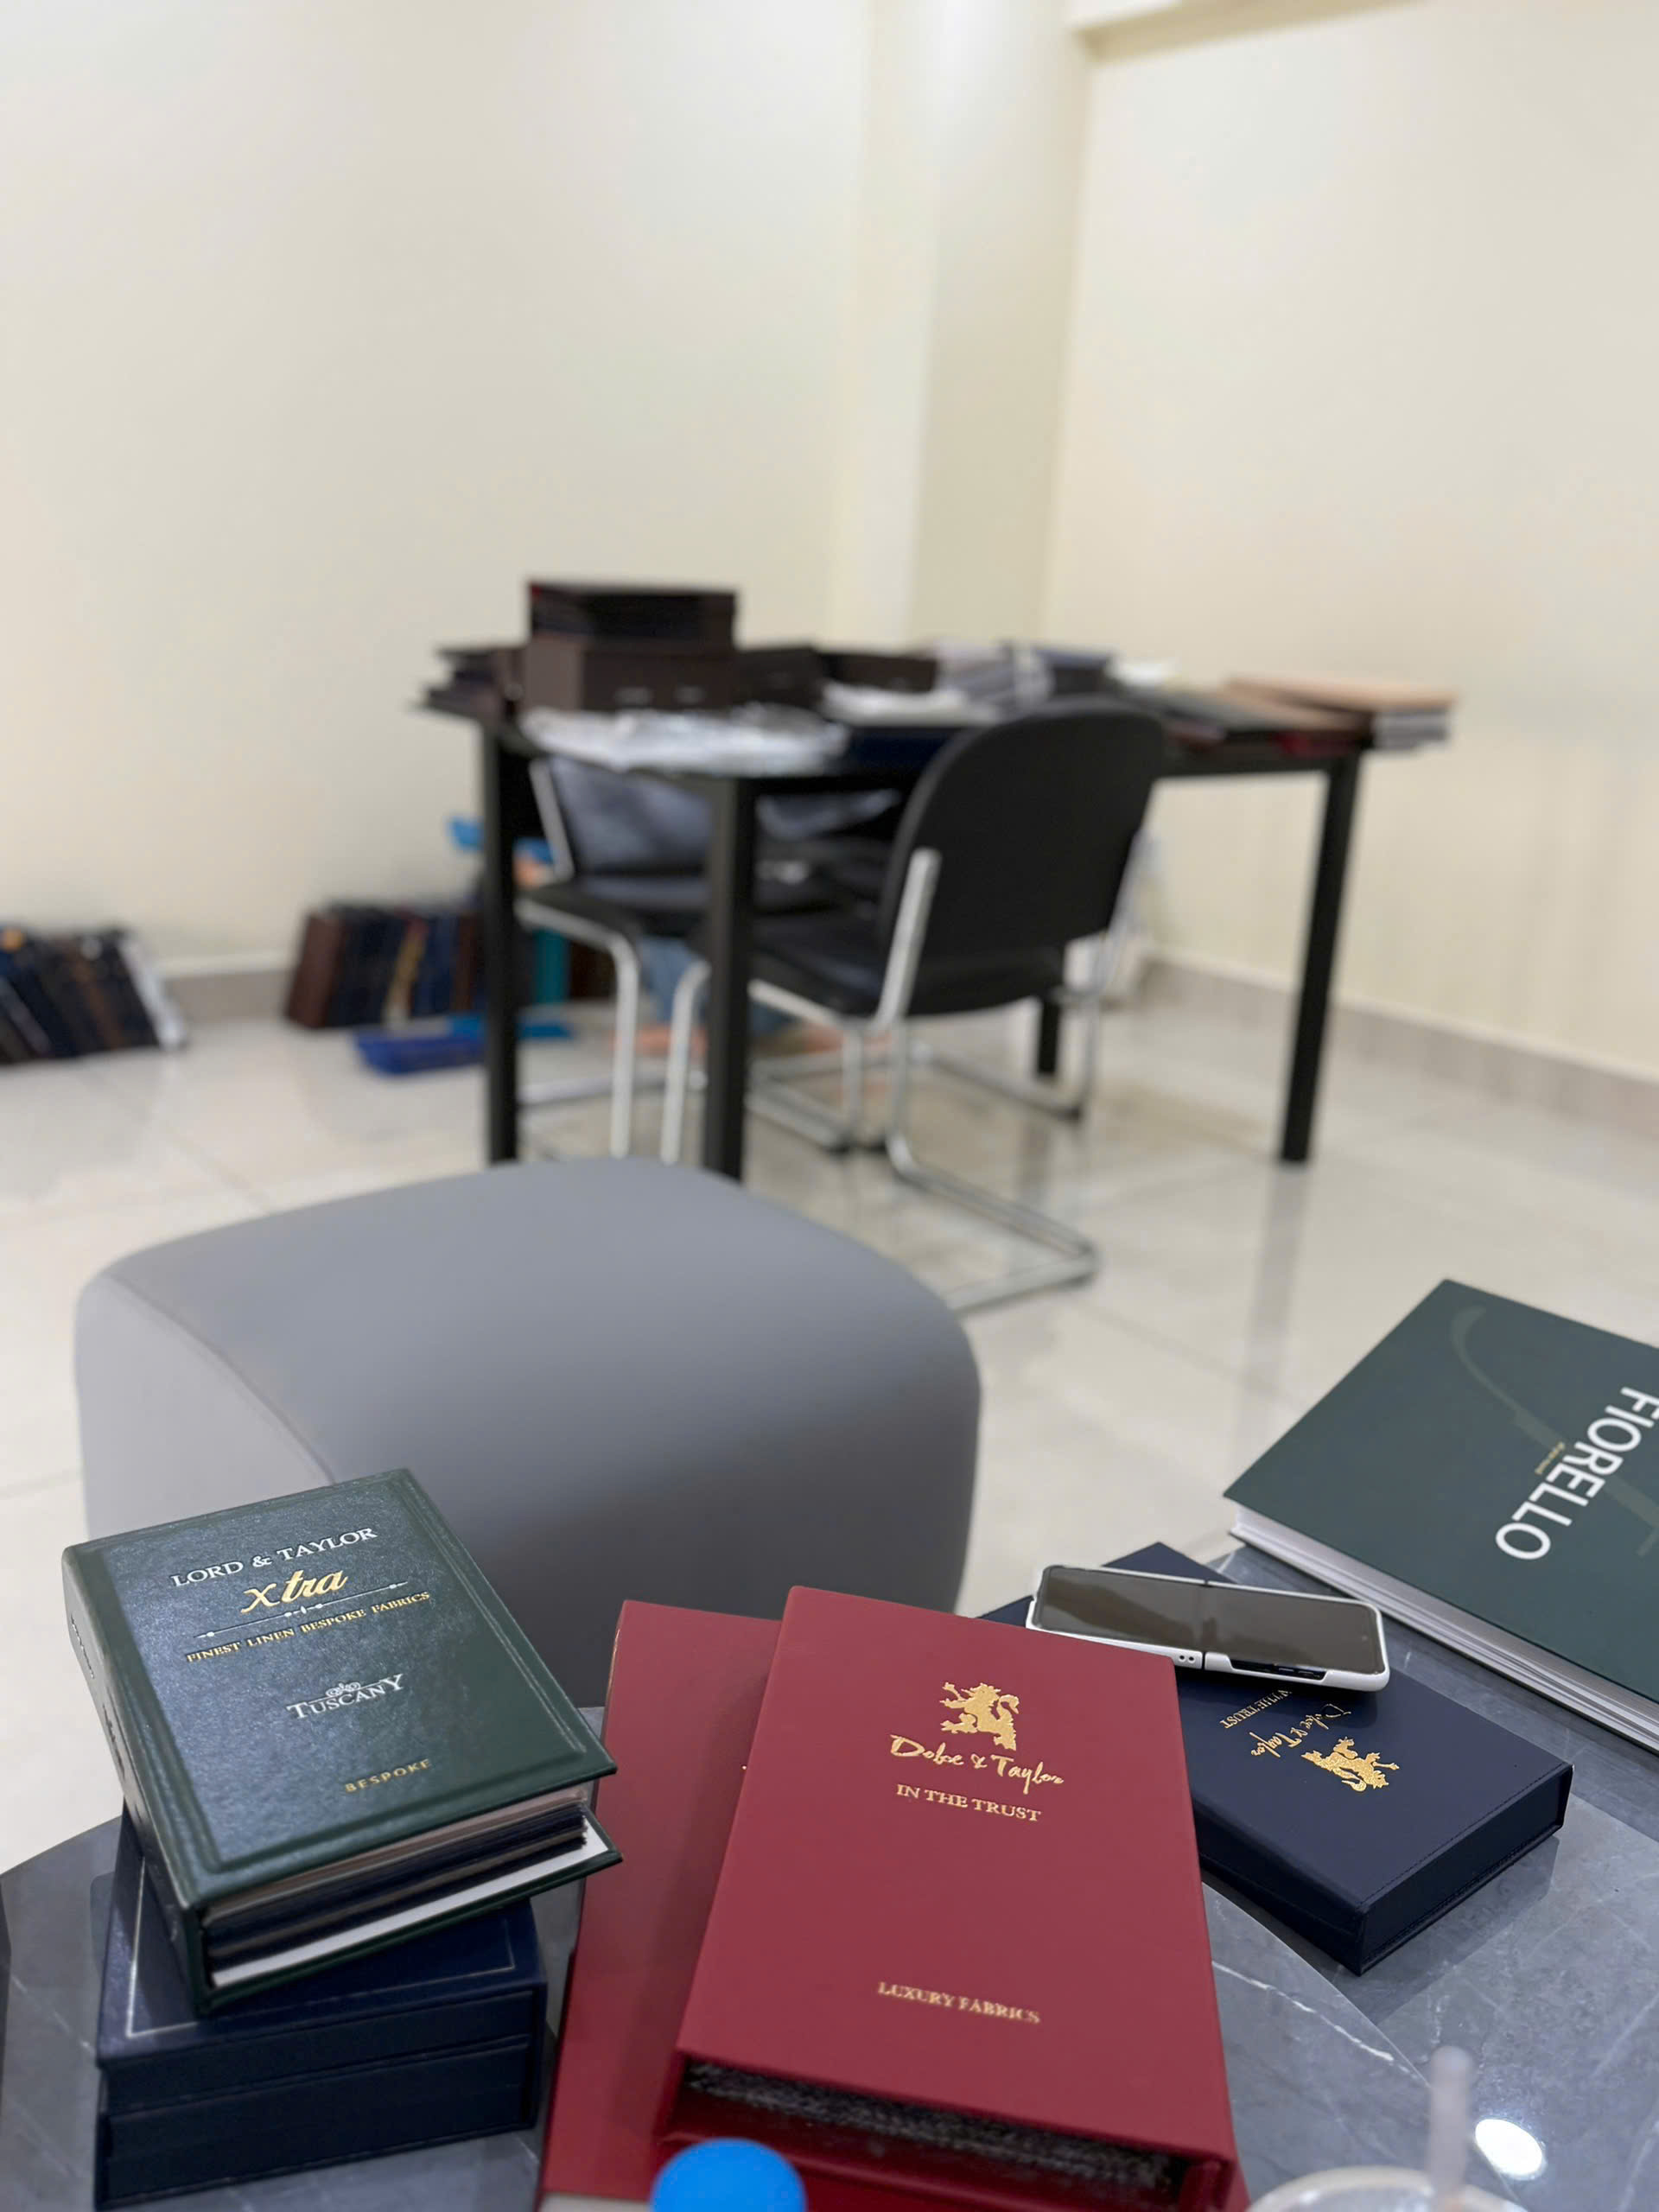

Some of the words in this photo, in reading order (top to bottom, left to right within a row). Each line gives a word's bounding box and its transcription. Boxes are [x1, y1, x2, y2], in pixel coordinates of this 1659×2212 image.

[1496, 1387, 1659, 1560] FIORELLO
[170, 1560, 244, 1587] LORD
[252, 1555, 272, 1567] &
[276, 1528, 378, 1560] TAYLOR
[240, 1569, 348, 1614] xtra
[186, 1641, 241, 1662] FINEST
[246, 1628, 295, 1647] LINEN
[300, 1609, 367, 1634] BESPOKE
[371, 1592, 430, 1614] FABRICS
[286, 1673, 404, 1719] TUSCANY
[1219, 1705, 1260, 1729] TRUST
[1255, 1692, 1284, 1710] THE
[1249, 1732, 1302, 1758] Taylor
[1290, 1726, 1308, 1738] &
[345, 1758, 430, 1793] BESPOKE
[970, 1753, 988, 1769] &
[990, 1754, 1065, 1795] Taylor
[896, 1783, 920, 1799] IN
[924, 1789, 968, 1808] THE
[971, 1797, 1042, 1821] TRUST
[878, 1981, 955, 2007] LUXURY
[958, 1995, 1041, 2024] FABRICS
